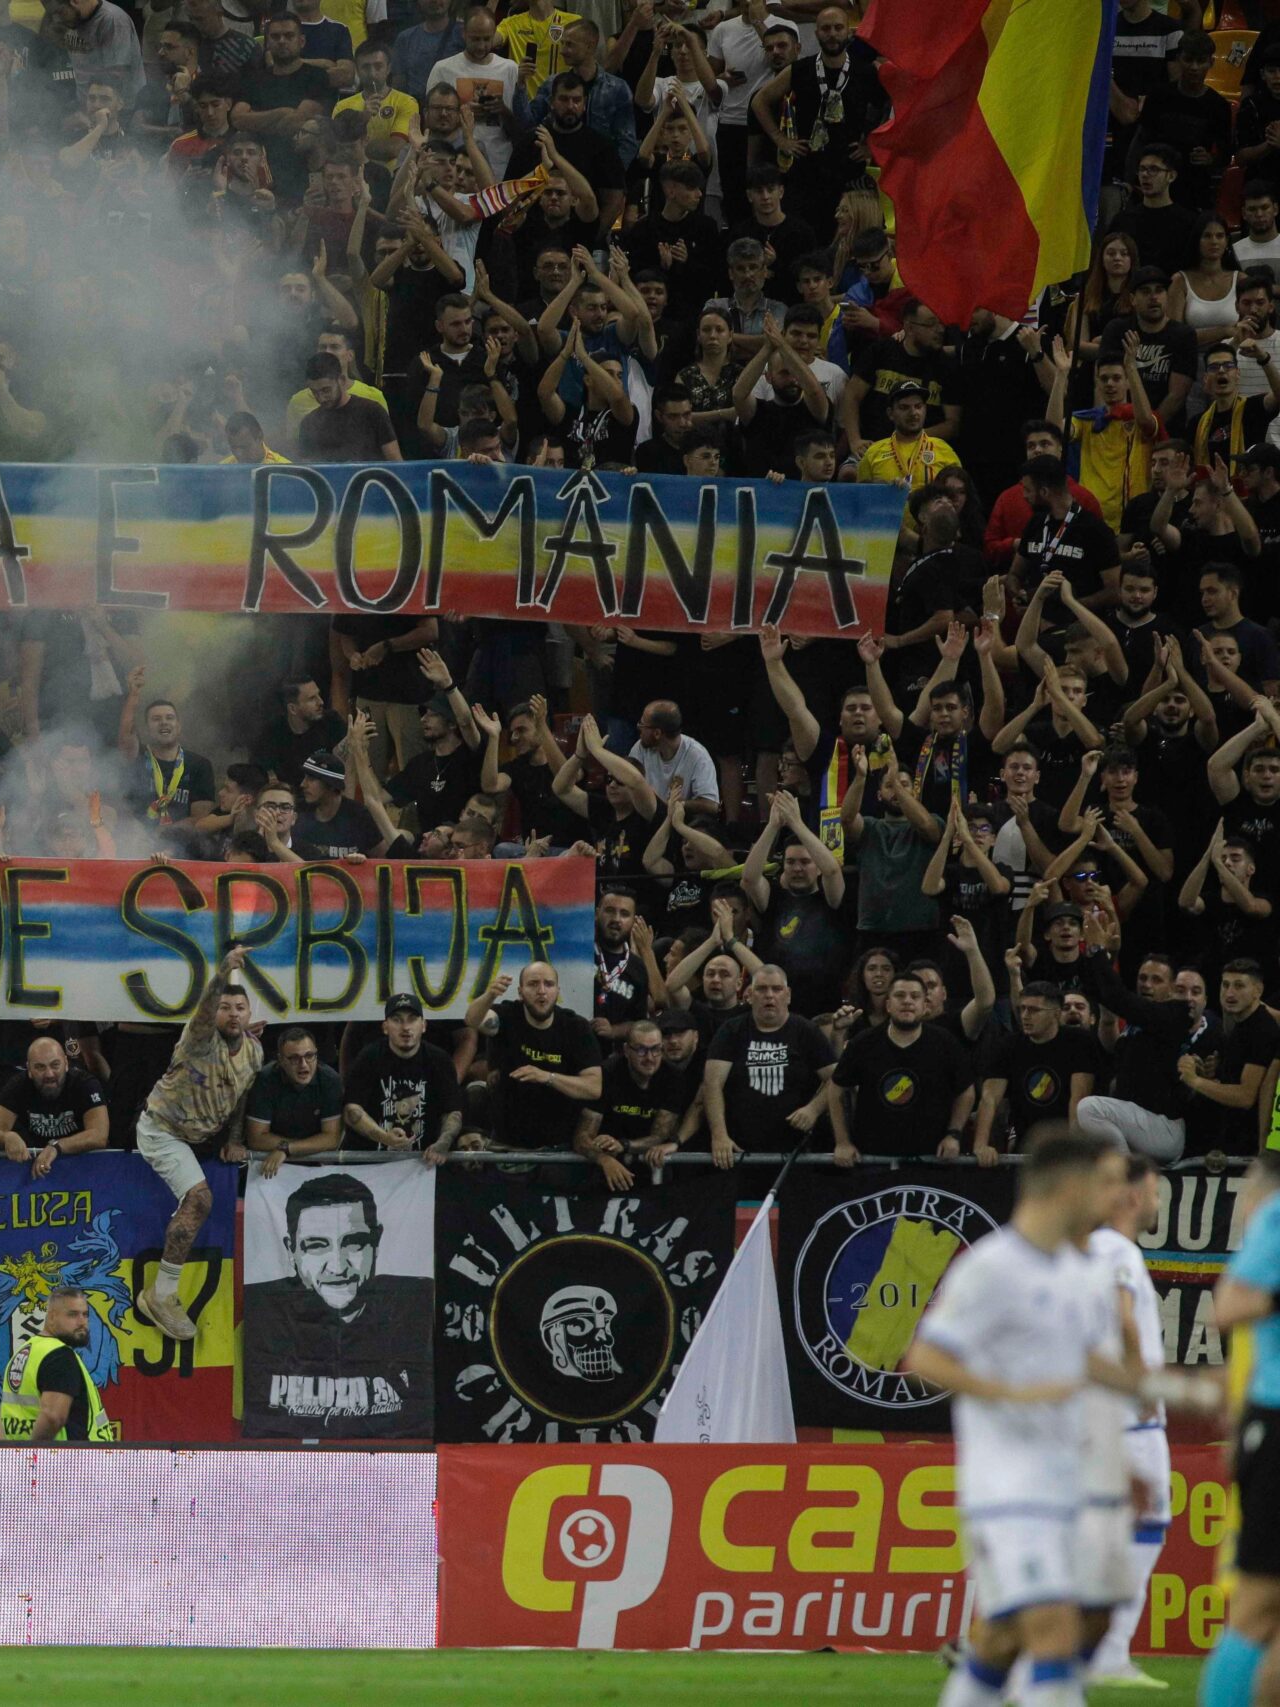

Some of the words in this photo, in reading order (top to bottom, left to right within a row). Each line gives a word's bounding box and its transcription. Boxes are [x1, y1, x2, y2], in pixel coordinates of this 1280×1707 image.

[94, 466, 170, 611] E
[242, 465, 867, 630] ROMÂNIA
[120, 863, 556, 1019] SRBIJA
[698, 1464, 967, 1573] cas
